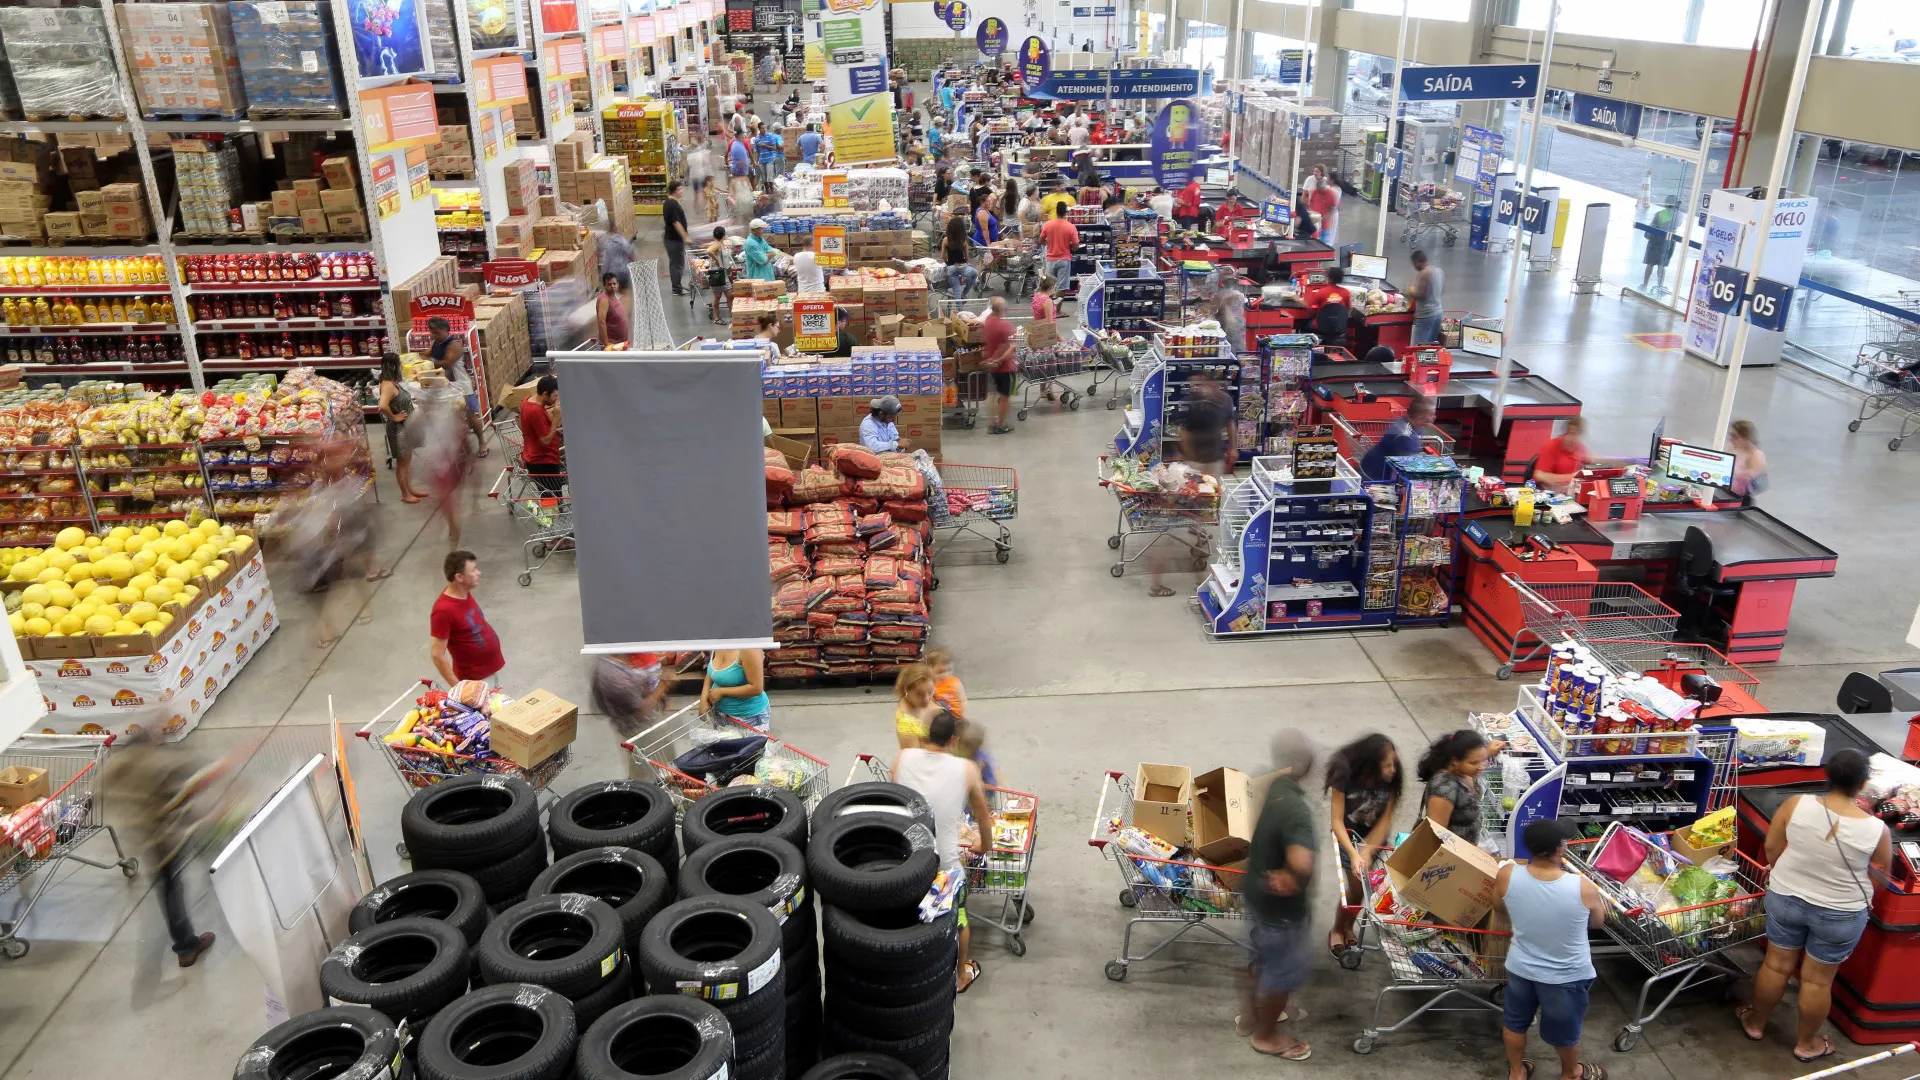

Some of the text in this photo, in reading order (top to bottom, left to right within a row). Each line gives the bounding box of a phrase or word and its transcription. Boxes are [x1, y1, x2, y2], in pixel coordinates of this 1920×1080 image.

[478, 79, 488, 88] 02
[1057, 84, 1193, 94] ATENDIMENTO ATENDIMENTO
[1423, 74, 1473, 93] SAÍDA
[619, 110, 644, 118] KITANO
[1591, 107, 1617, 126] SAÍDA
[366, 114, 383, 128] 01
[1375, 152, 1382, 161] 10
[1388, 157, 1396, 169] 09
[1500, 200, 1512, 216] 08
[1524, 206, 1540, 223] 07
[52, 222, 72, 230] Quero
[88, 220, 107, 229] Quero
[494, 274, 530, 284] Royal
[1714, 280, 1736, 302] 06
[418, 295, 462, 308] Royal
[1753, 294, 1776, 316] 05
[1420, 866, 1456, 882] NESCAU
